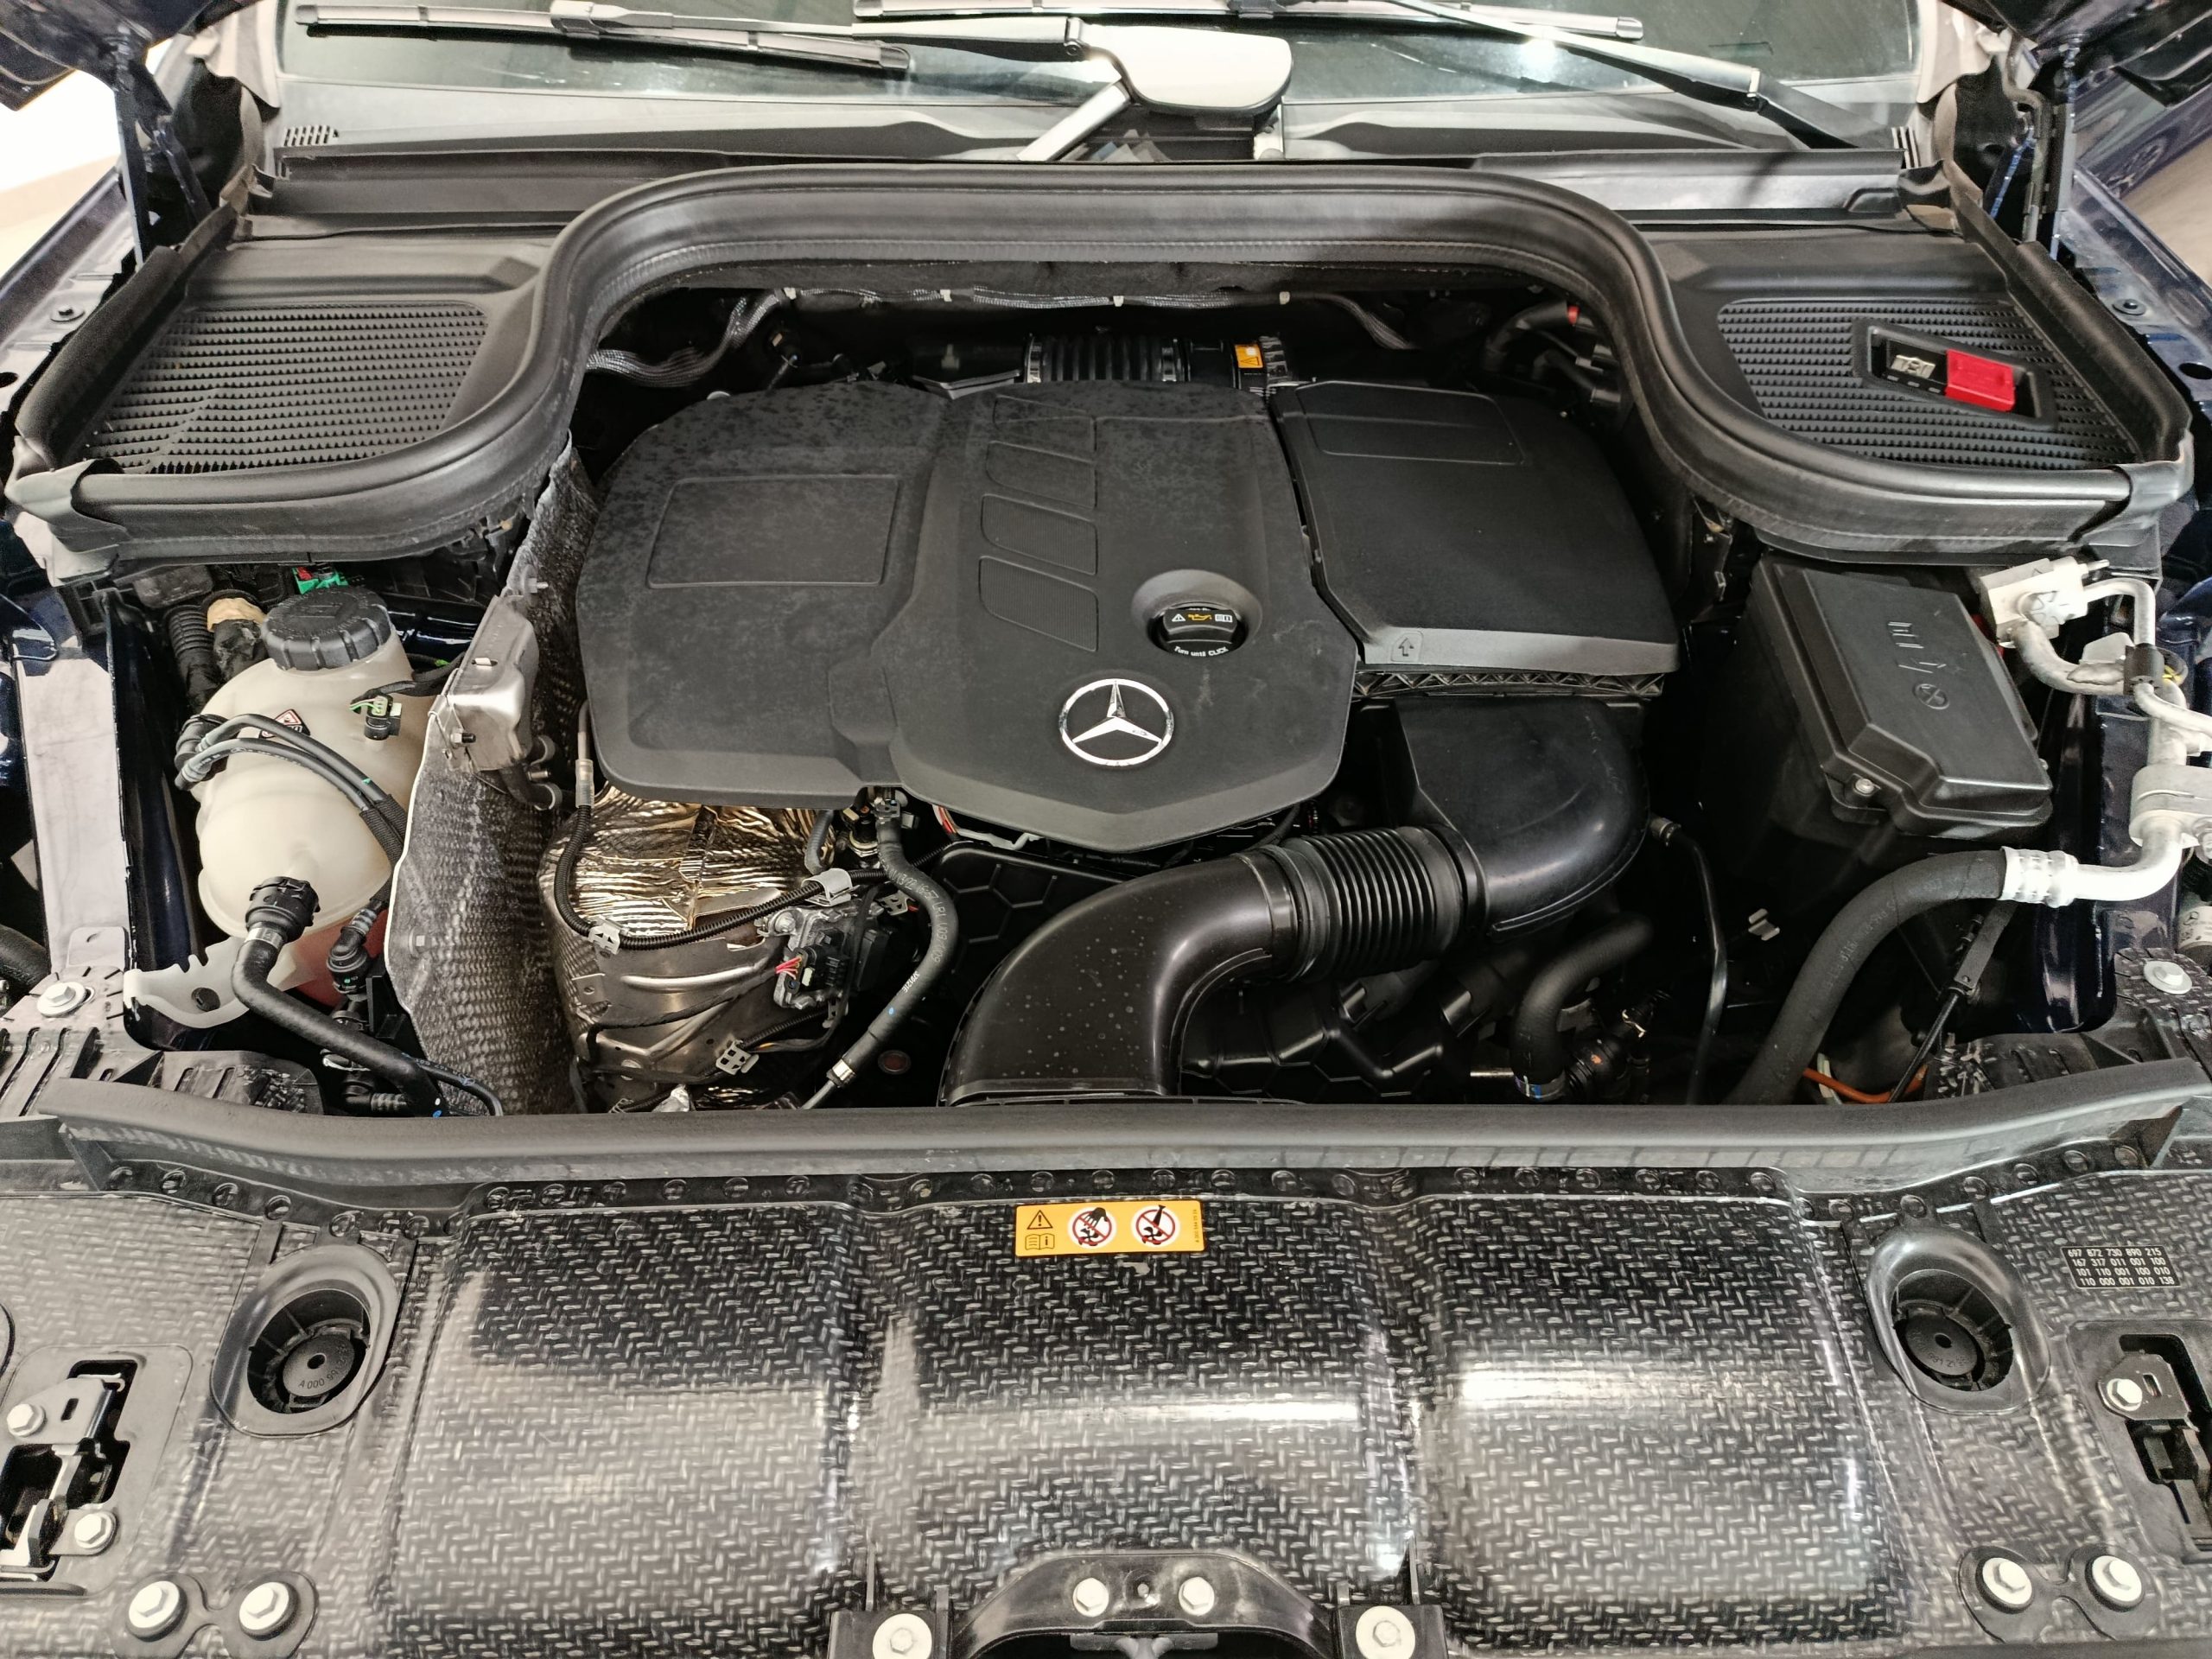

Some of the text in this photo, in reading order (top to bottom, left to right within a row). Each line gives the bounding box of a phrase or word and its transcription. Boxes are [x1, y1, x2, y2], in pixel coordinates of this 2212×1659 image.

[1174, 645, 1189, 655] Turn
[1208, 646, 1229, 656] CLICK
[2086, 1249, 2103, 1257] 872
[2106, 1249, 2123, 1257] 730
[2126, 1248, 2142, 1256] 890
[2145, 1248, 2162, 1256] 215
[2072, 1258, 2086, 1267] 167
[2129, 1257, 2146, 1266] 001
[2075, 1268, 2091, 1276] 101
[2095, 1268, 2112, 1276] 110
[2135, 1267, 2151, 1275] 100
[2153, 1267, 2171, 1275] 010
[2080, 1277, 2096, 1286] 110
[2099, 1277, 2115, 1286] 000
[2119, 1277, 2135, 1286] 001
[2158, 1276, 2175, 1285] 138
[298, 1380, 305, 1389] A
[307, 1377, 325, 1389] 000
